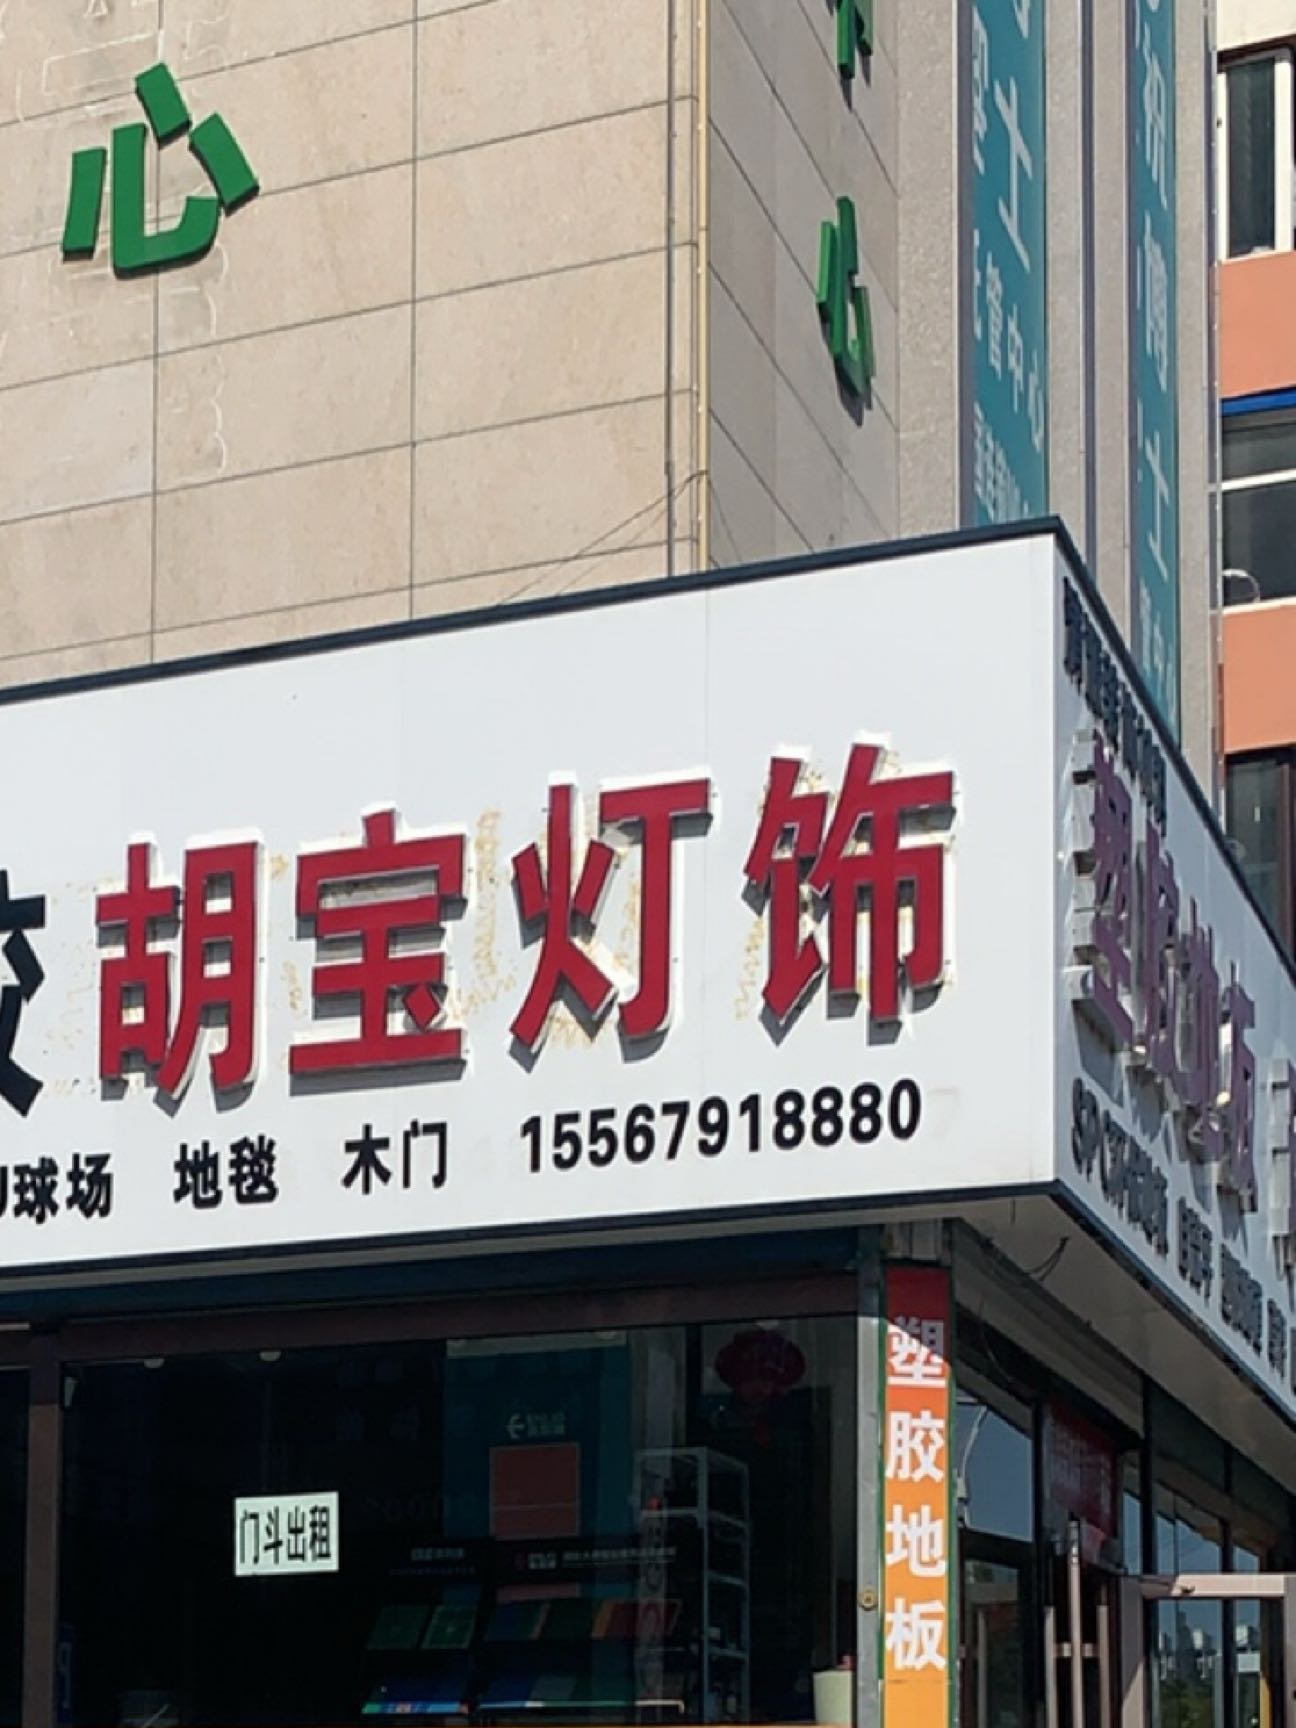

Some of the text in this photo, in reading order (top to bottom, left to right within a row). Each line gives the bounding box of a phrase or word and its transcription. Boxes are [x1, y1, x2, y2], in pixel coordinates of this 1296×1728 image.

[62, 61, 260, 279] 心
[94, 742, 956, 1099] 胡宝灯饰
[173, 1134, 279, 1209] 地毯
[343, 1119, 448, 1196] 木门
[520, 1078, 922, 1174] 15567918880
[239, 1503, 332, 1565] 门斗出租
[884, 1315, 948, 1672] 塑胶地板
